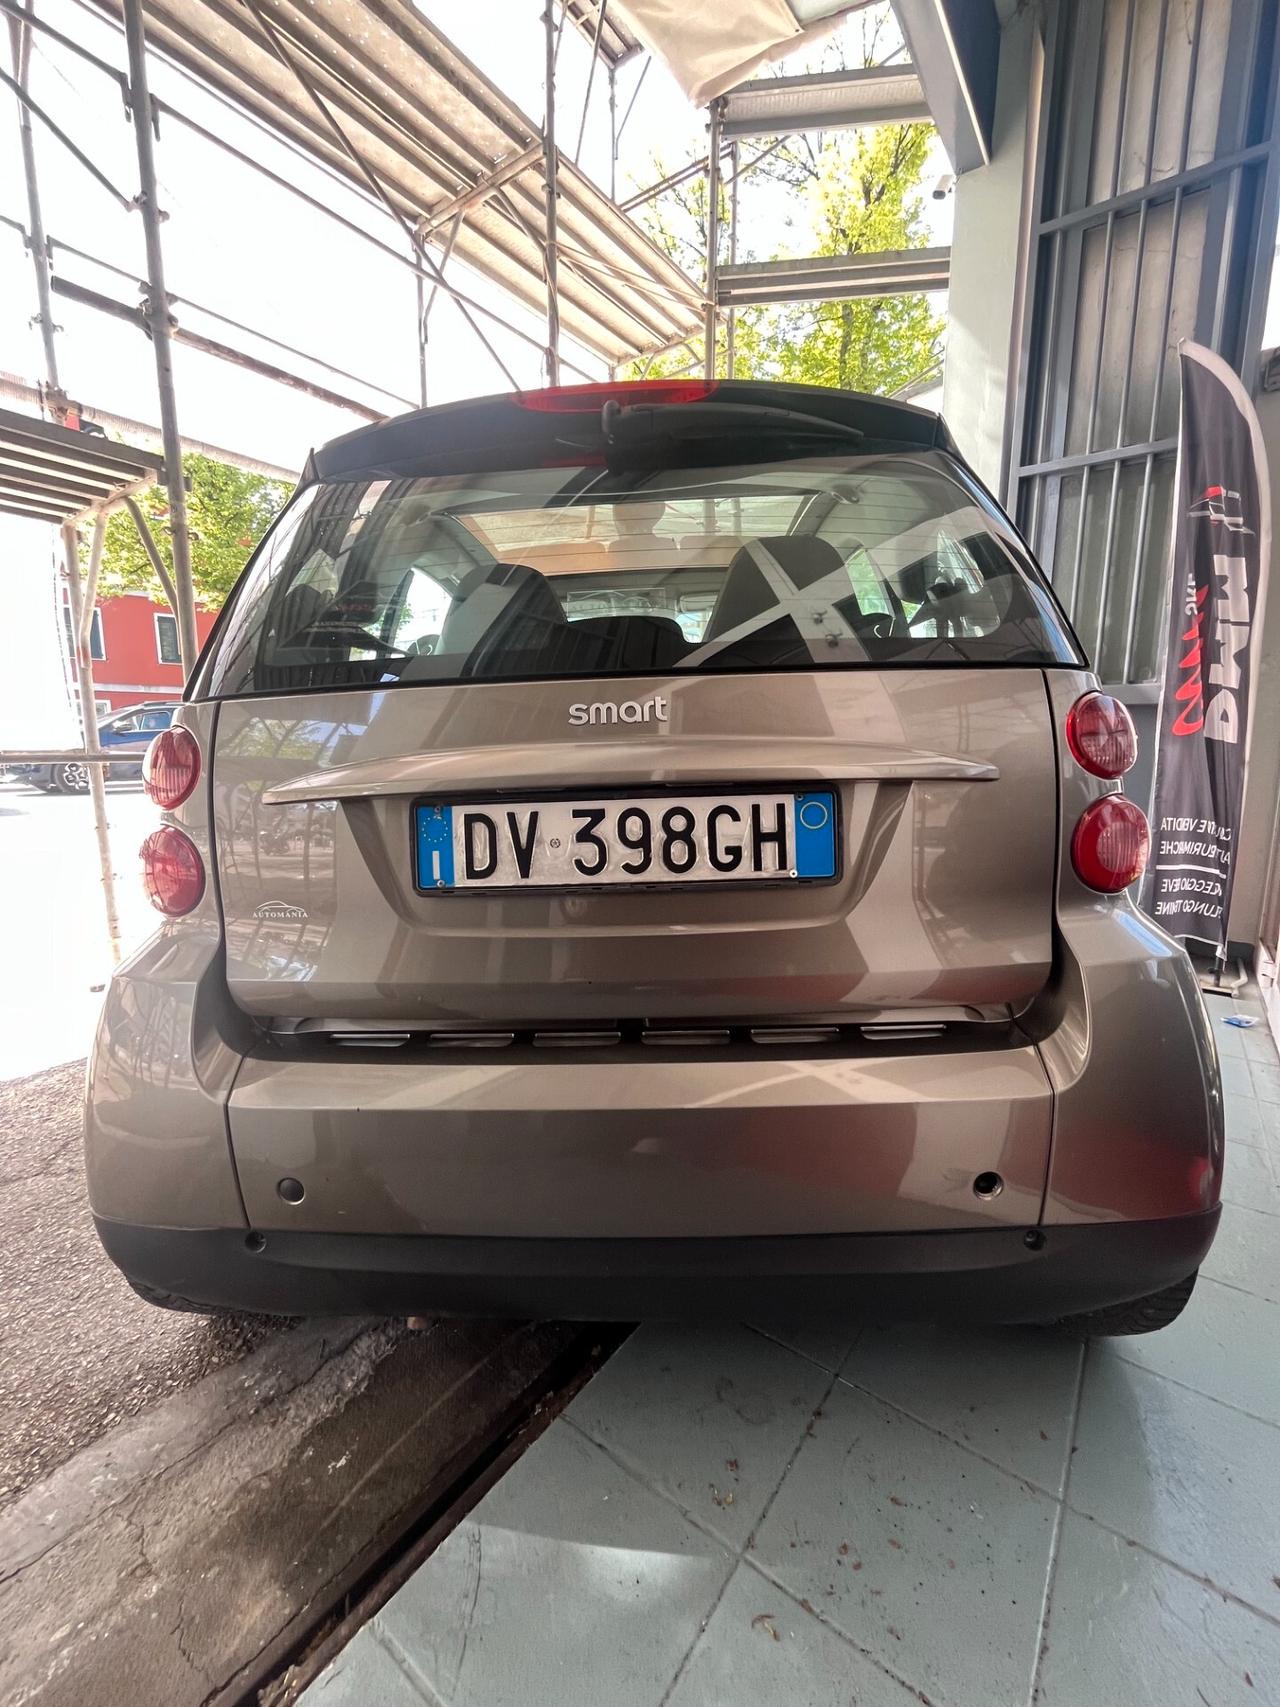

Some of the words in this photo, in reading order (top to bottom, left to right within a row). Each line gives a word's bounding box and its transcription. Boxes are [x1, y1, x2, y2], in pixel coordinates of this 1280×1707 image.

[568, 696, 668, 725] smart
[463, 810, 539, 879] DV
[571, 802, 788, 877] 398GH
[252, 911, 309, 919] AUTOMANIA
